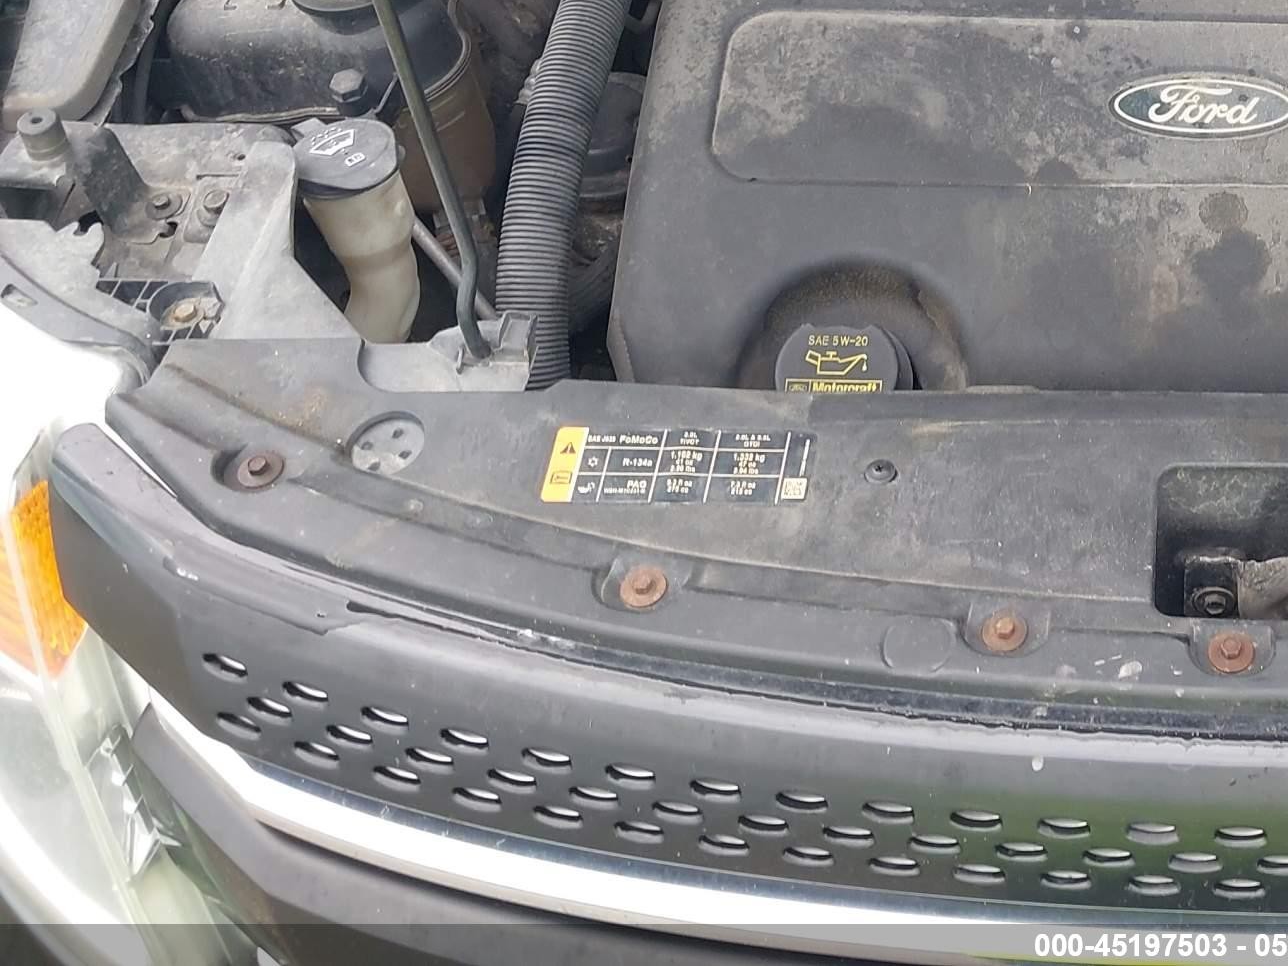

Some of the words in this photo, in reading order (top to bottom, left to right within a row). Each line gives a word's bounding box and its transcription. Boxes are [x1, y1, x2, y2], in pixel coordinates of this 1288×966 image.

[1148, 84, 1260, 124] Ford
[808, 334, 829, 347] SAE
[619, 434, 659, 445] FoMoCo
[622, 457, 653, 467] R-134a
